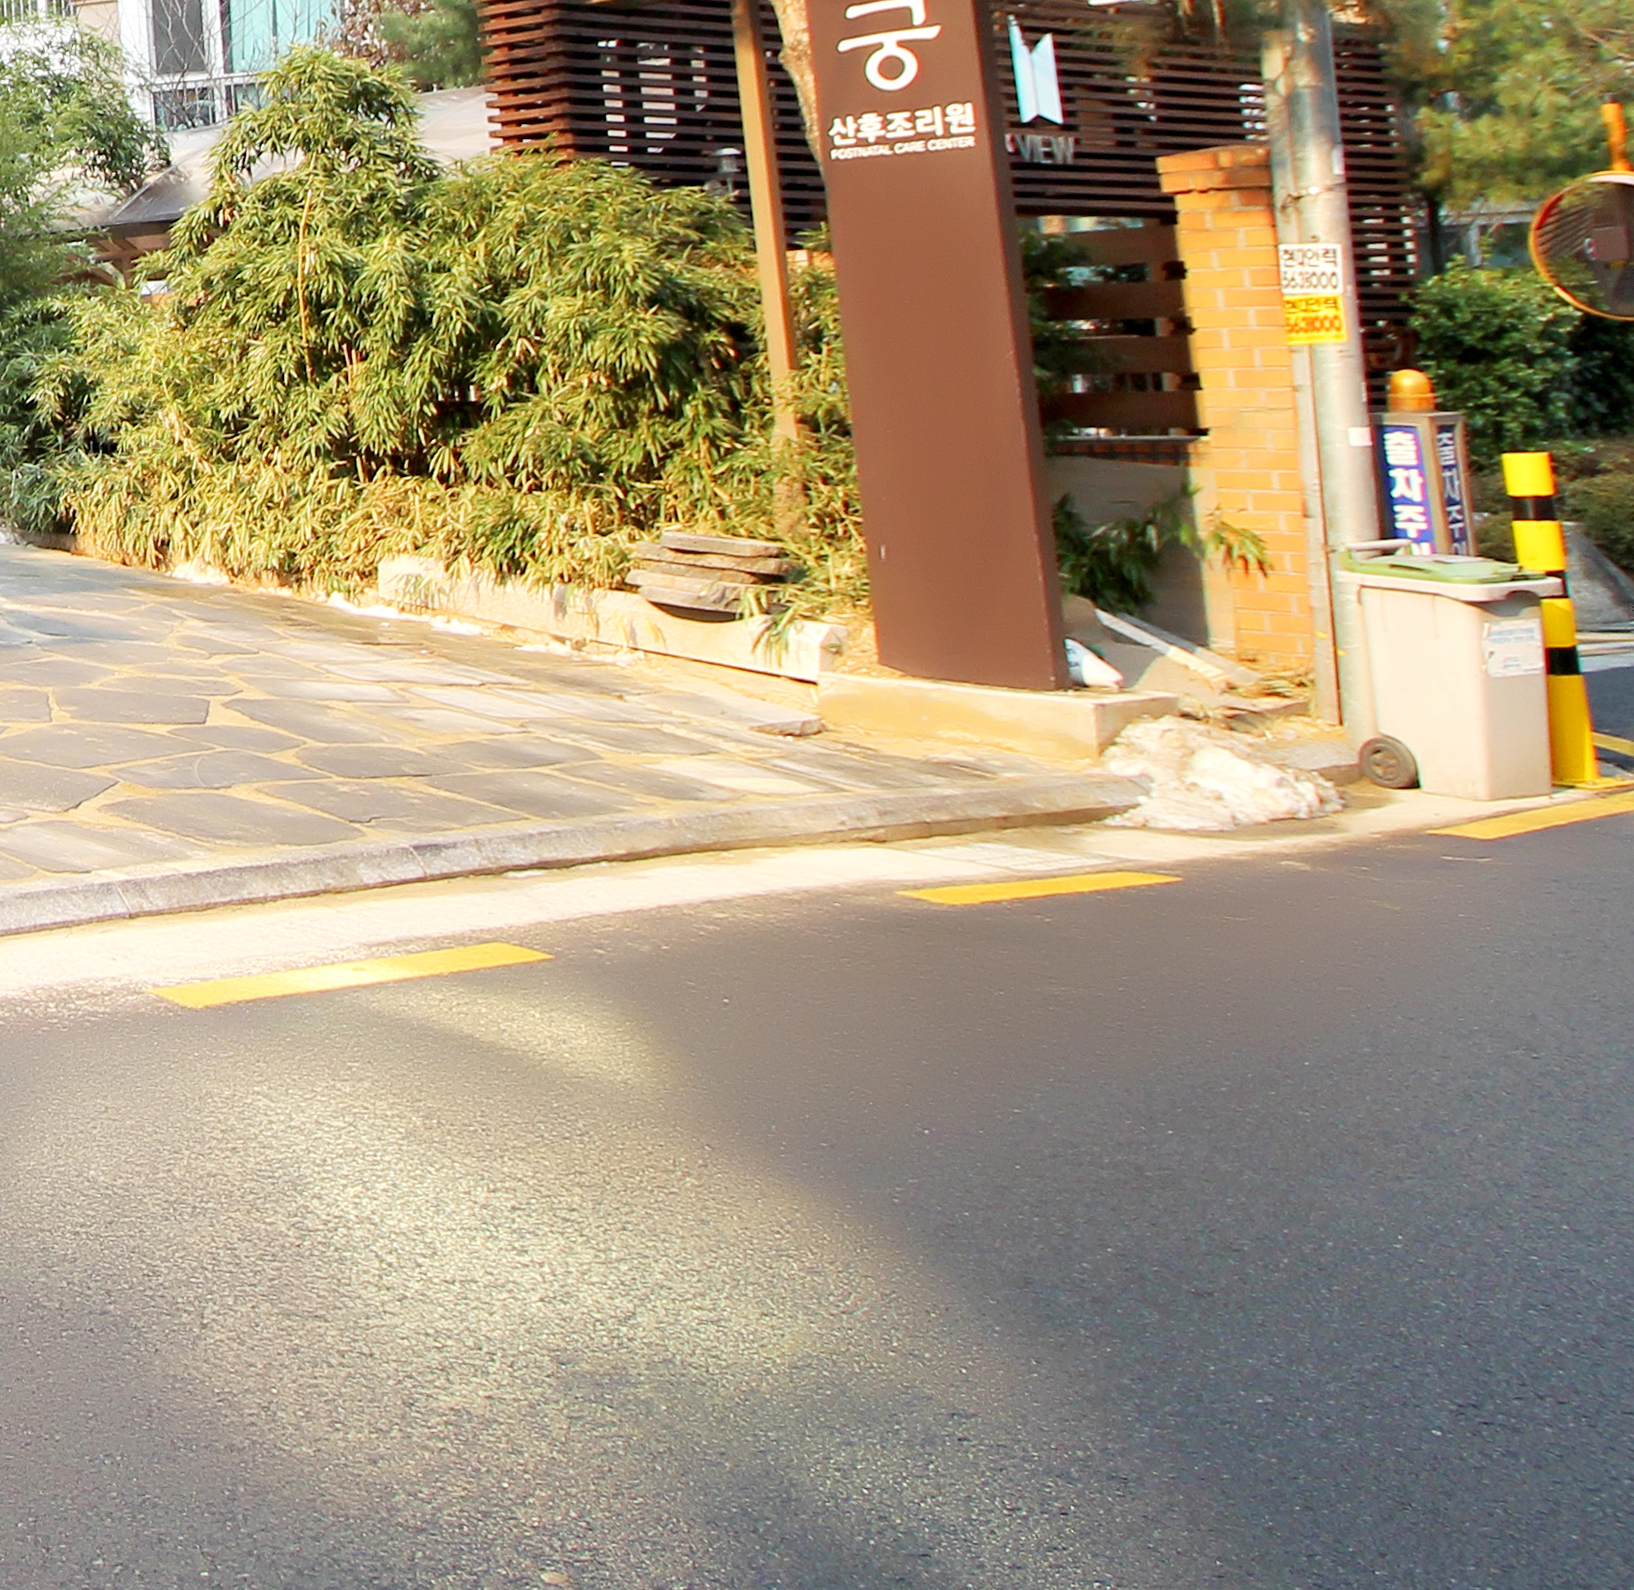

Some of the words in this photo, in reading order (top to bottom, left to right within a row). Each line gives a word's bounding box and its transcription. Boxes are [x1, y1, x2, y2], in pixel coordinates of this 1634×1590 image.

[828, 102, 977, 146] 산후조리원
[830, 144, 893, 160] POSTNATAL
[893, 139, 926, 155] CARE
[927, 135, 977, 151] CENTER
